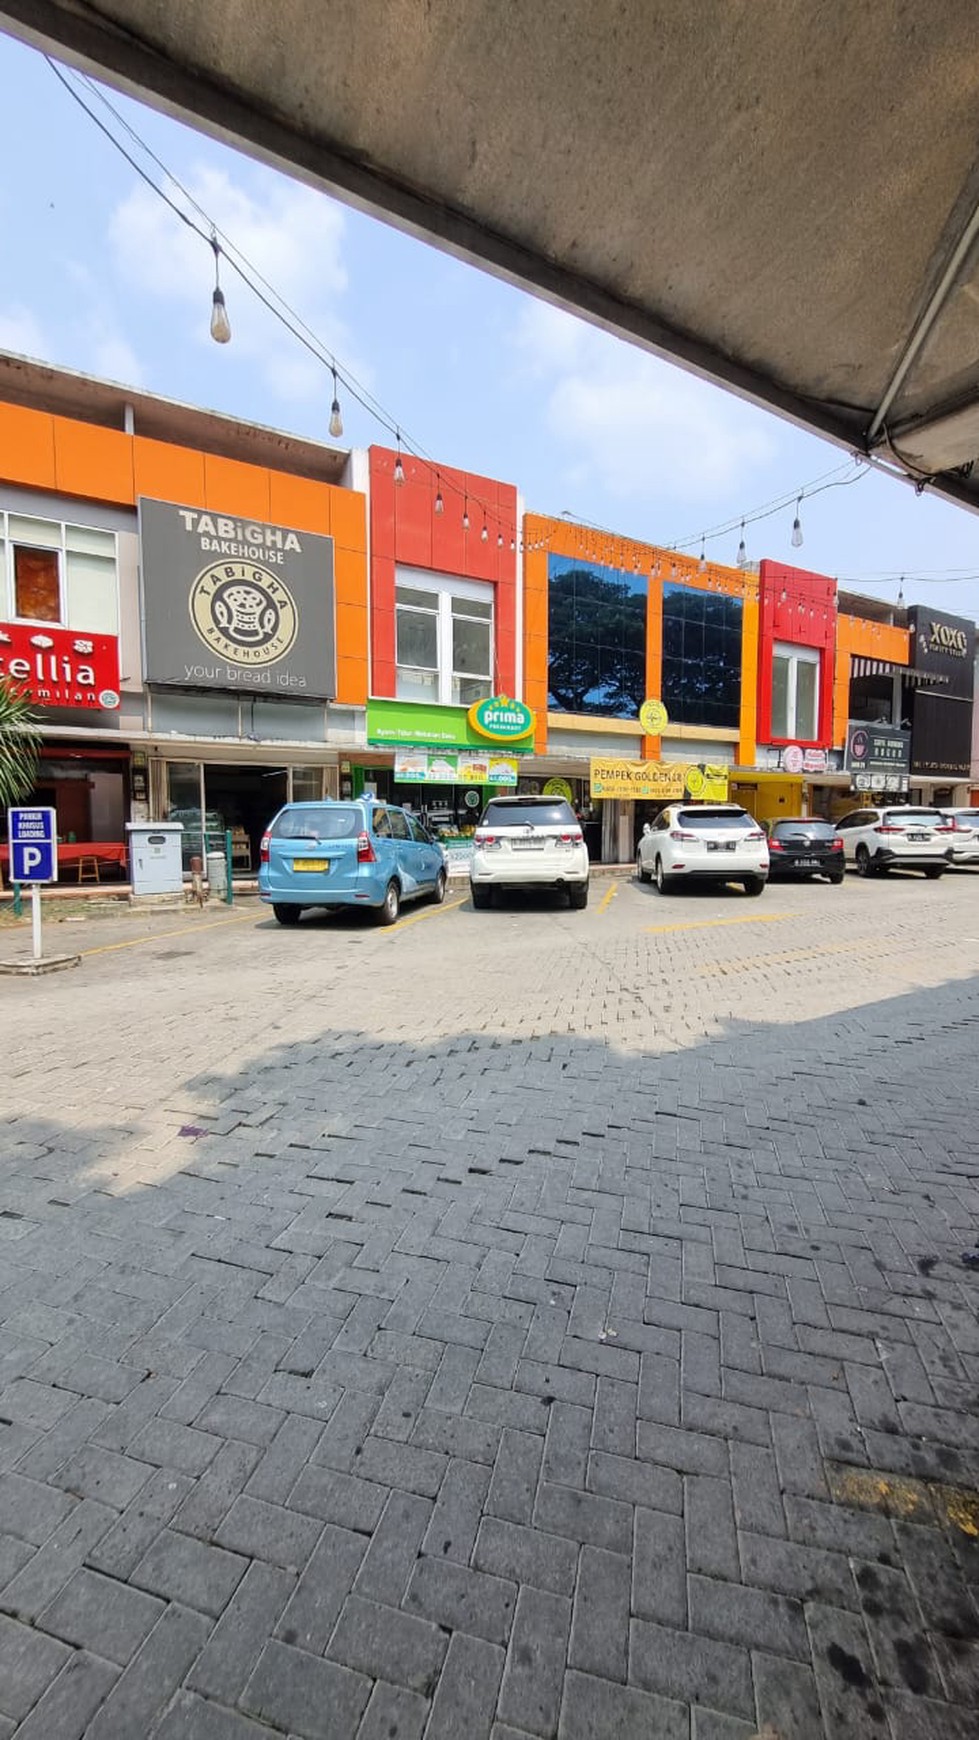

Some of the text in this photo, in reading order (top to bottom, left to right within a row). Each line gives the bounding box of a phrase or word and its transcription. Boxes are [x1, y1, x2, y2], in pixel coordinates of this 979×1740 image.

[200, 537, 284, 564] BAKEHOUSE
[206, 627, 284, 658] BAKEHOUSE
[184, 665, 306, 687] your bread idea
[484, 711, 525, 726] prima
[594, 769, 632, 781] PEMPEK
[18, 830, 45, 838] LOADING
[23, 847, 42, 875] P
